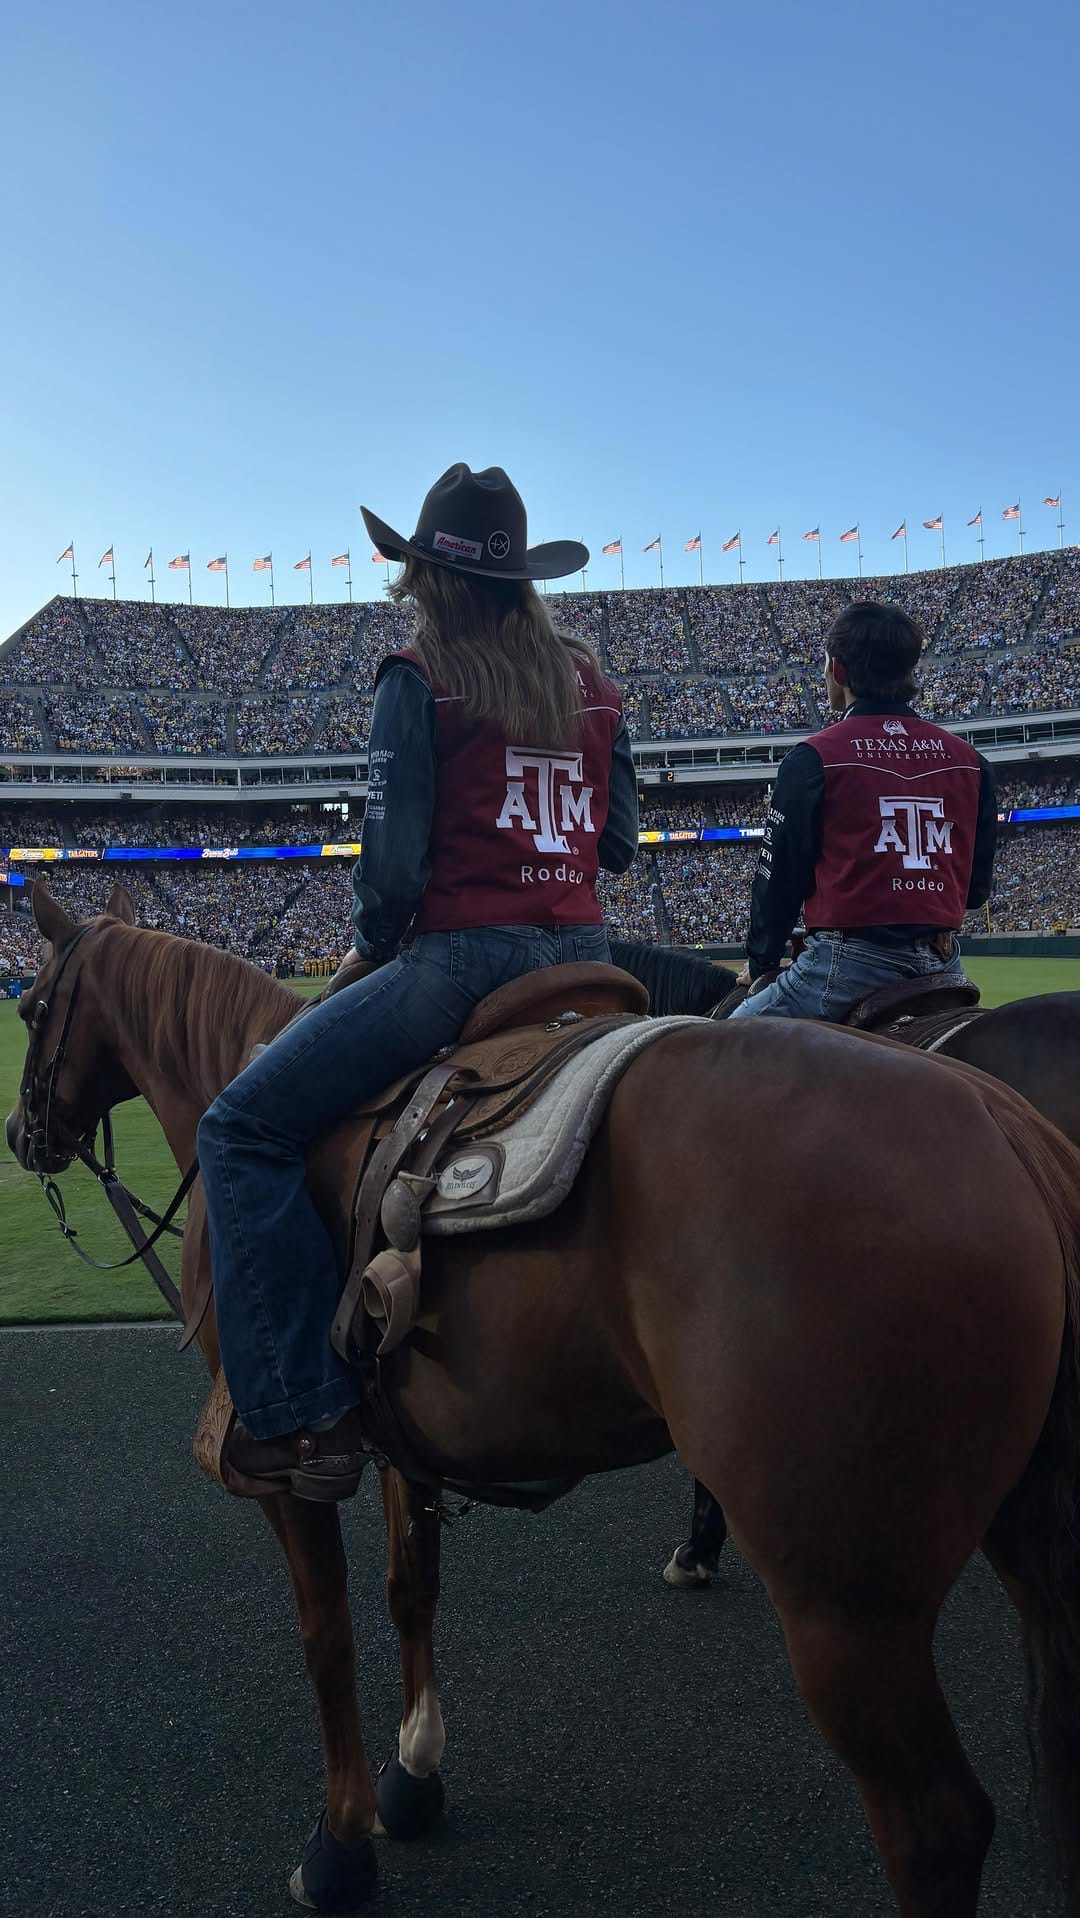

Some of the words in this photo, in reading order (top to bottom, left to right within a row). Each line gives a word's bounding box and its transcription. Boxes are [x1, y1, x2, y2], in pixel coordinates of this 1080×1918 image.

[437, 536, 477, 554] American
[851, 739, 907, 752] TEXAS
[911, 739, 945, 751] A&M
[857, 752, 946, 760] UNIVERSITY
[367, 791, 383, 801] YETI
[521, 864, 583, 884] Rodeo
[892, 877, 944, 892] Rodeo
